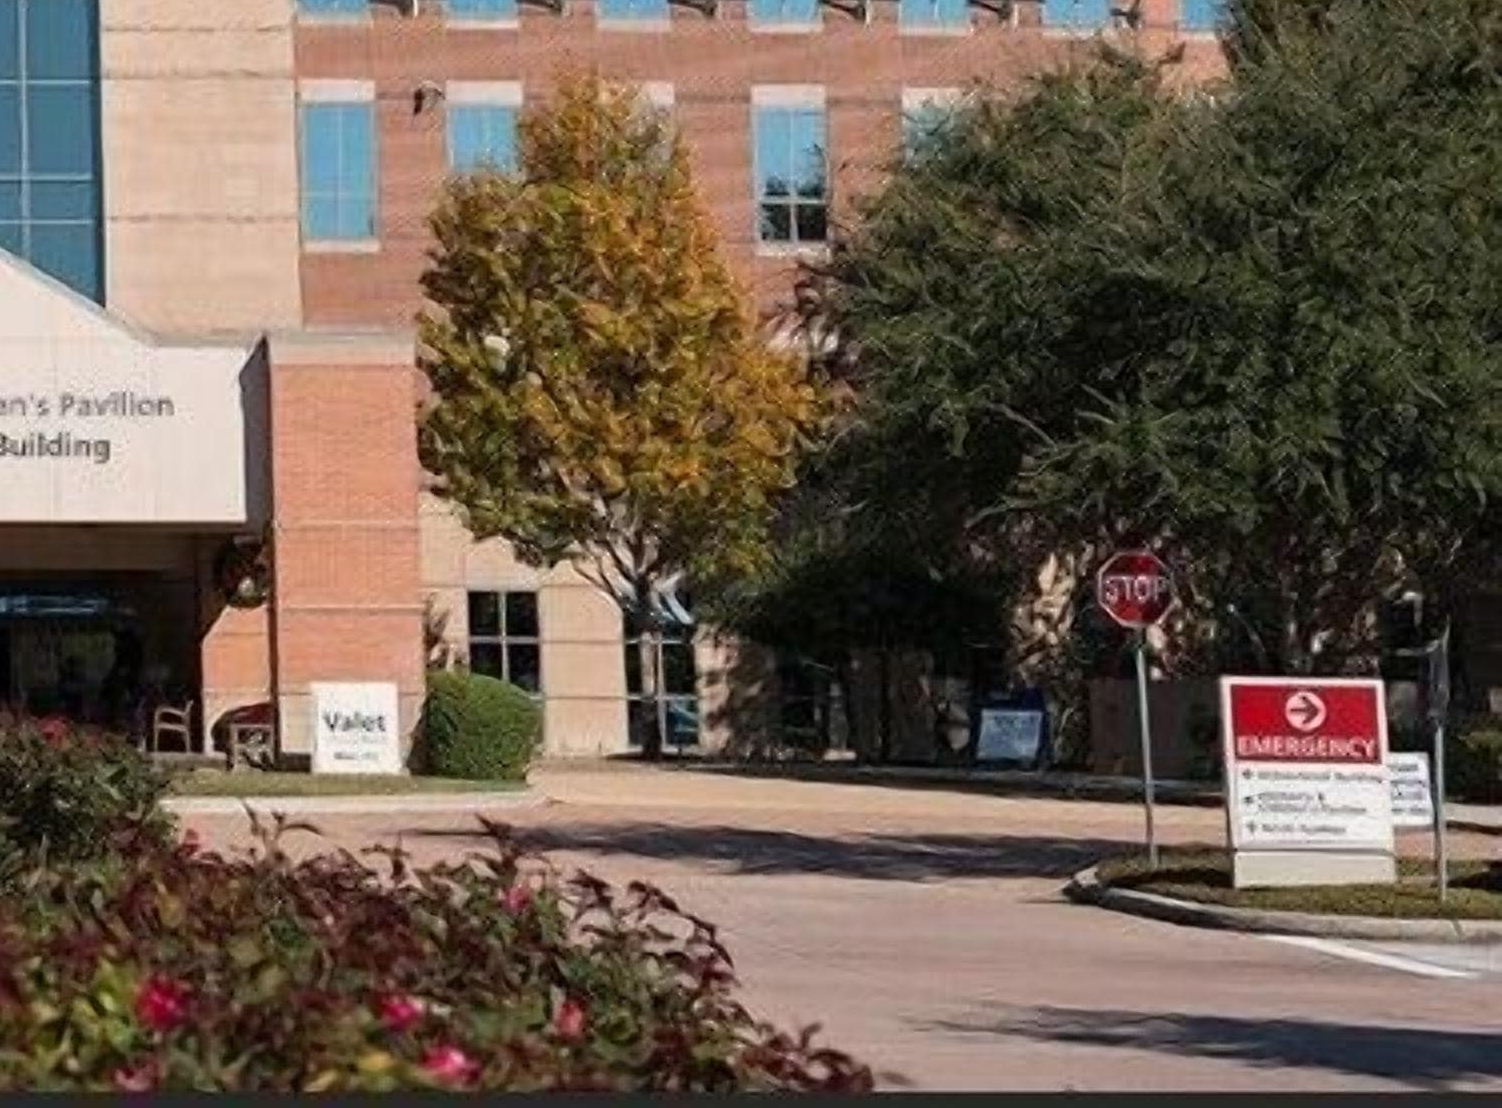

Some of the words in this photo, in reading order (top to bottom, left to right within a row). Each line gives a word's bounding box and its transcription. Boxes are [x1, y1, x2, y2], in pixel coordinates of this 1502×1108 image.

[60, 391, 175, 418] Pavilion
[1105, 575, 1168, 603] STOP
[1237, 735, 1374, 758] EMERGENCY
